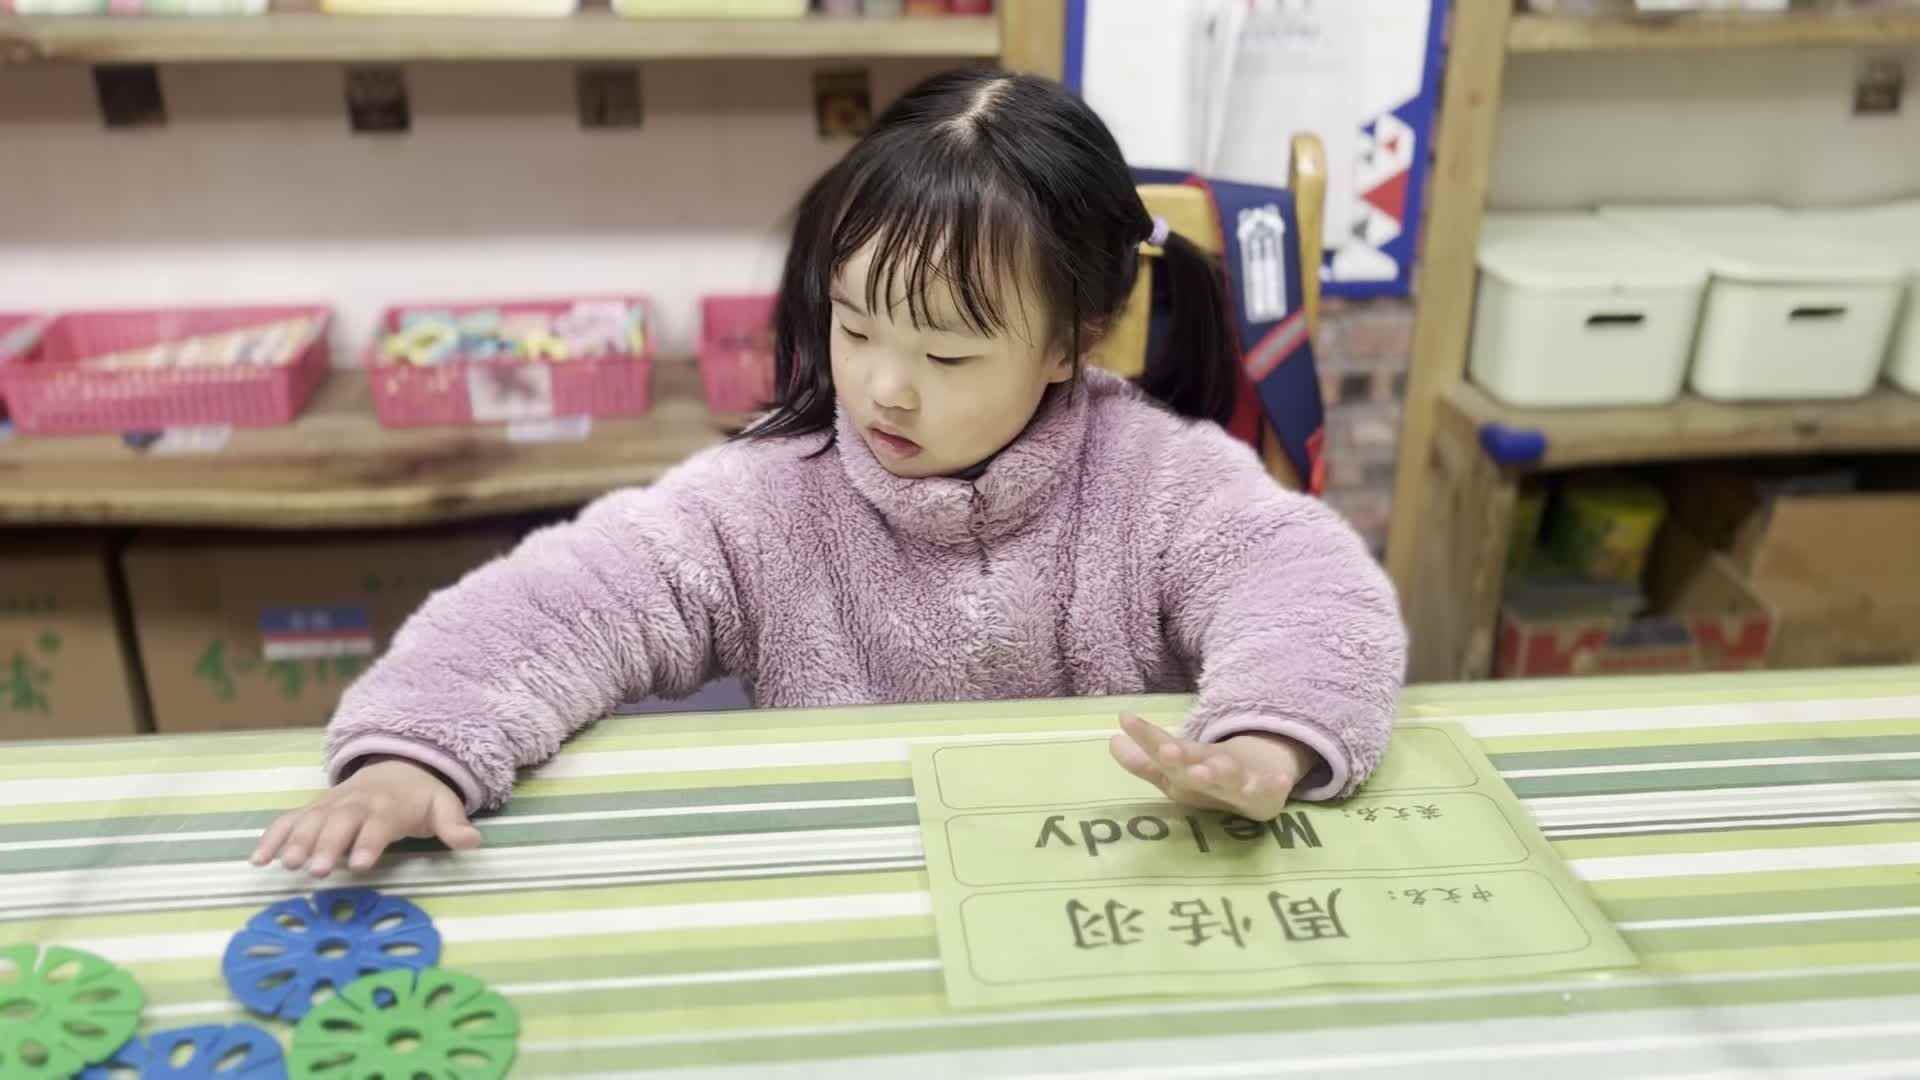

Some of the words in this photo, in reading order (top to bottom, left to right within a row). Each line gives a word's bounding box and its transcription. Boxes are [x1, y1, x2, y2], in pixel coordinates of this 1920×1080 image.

[1035, 811, 1322, 855] Melody
[1066, 888, 1349, 949] 周恬羽
